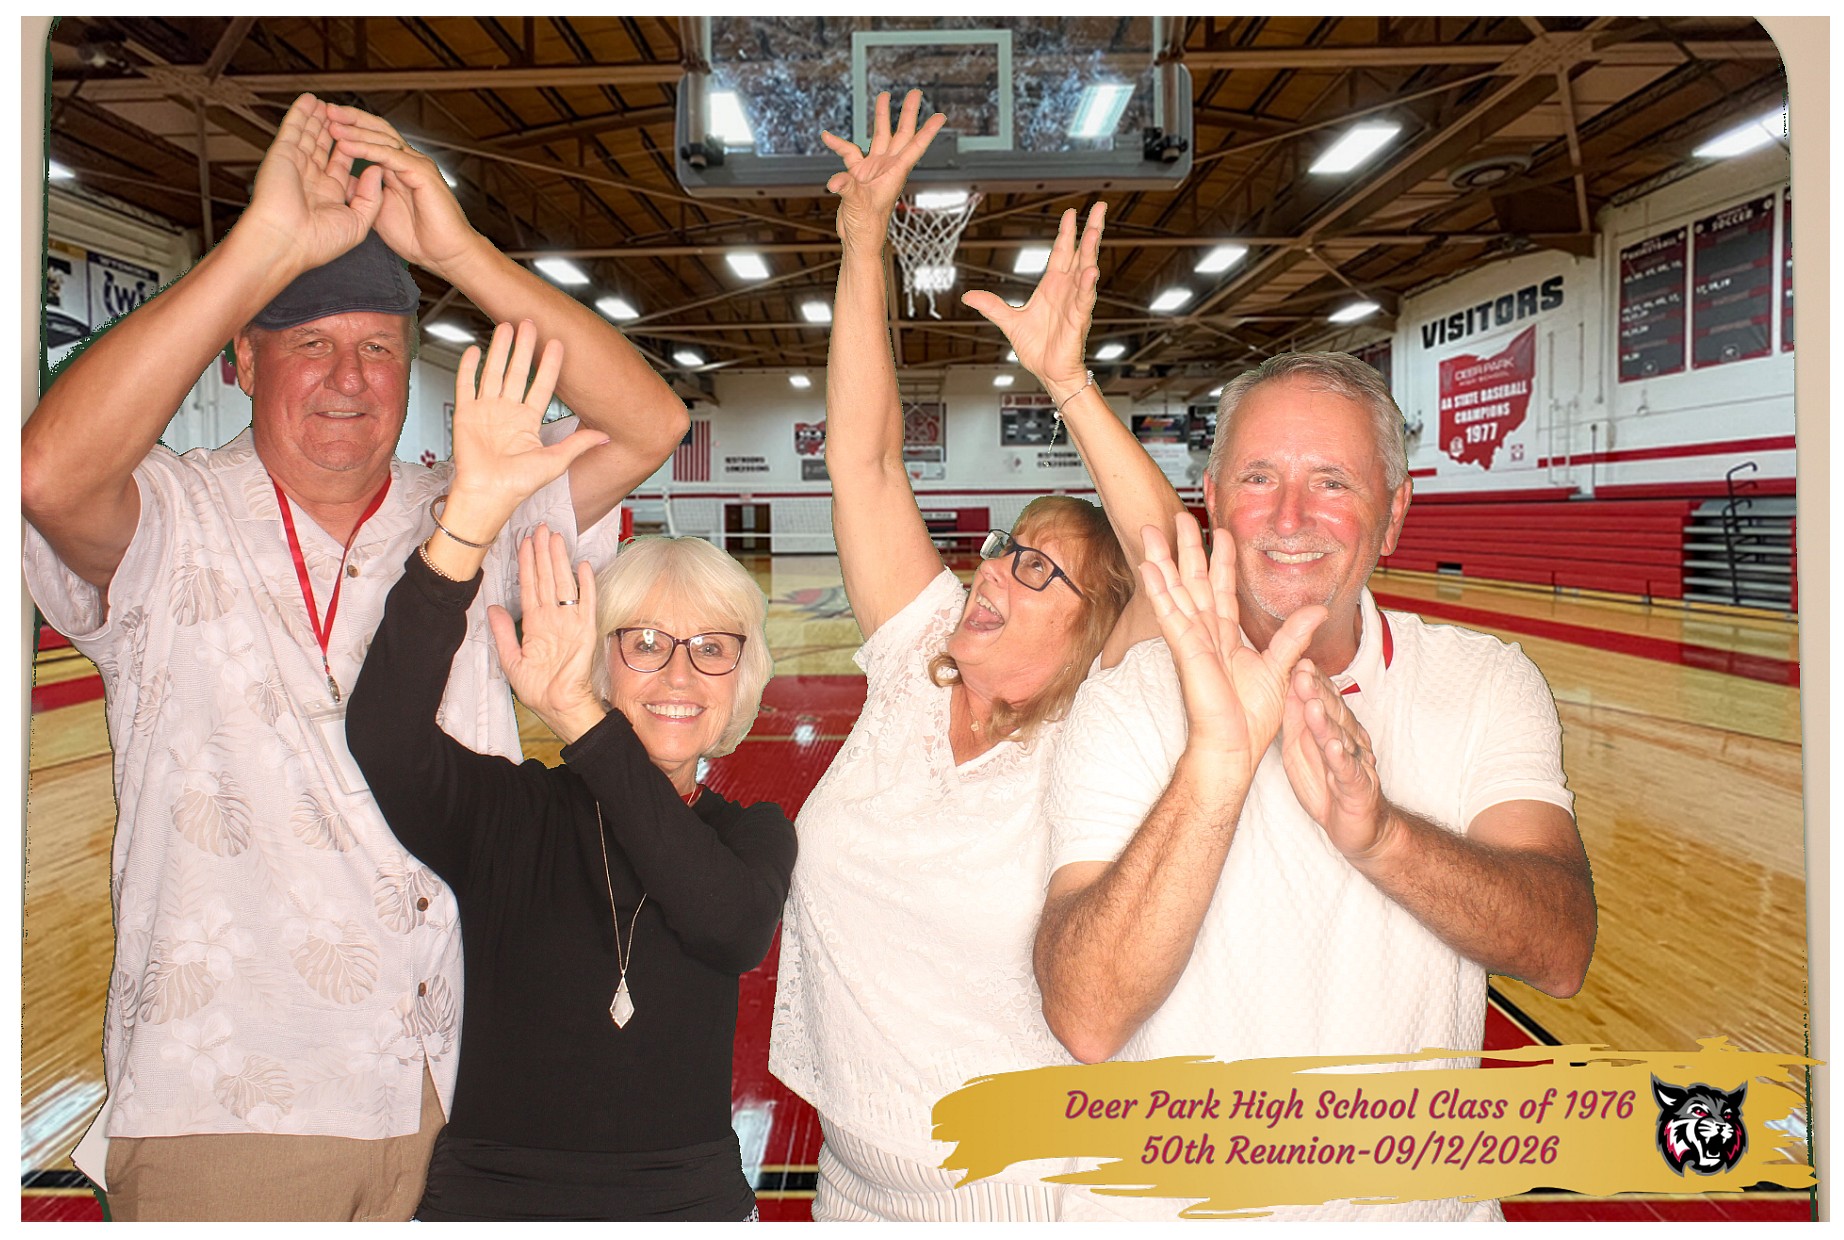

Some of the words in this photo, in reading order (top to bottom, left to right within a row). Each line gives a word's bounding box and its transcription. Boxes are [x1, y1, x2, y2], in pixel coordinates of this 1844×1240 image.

[1421, 275, 1564, 350] VISITORS
[1440, 397, 1453, 411] AA
[1453, 391, 1479, 408] STATE
[1480, 380, 1528, 403] BASEBALL
[1454, 402, 1511, 425] CHAMPIONS
[1465, 422, 1498, 444] 1977
